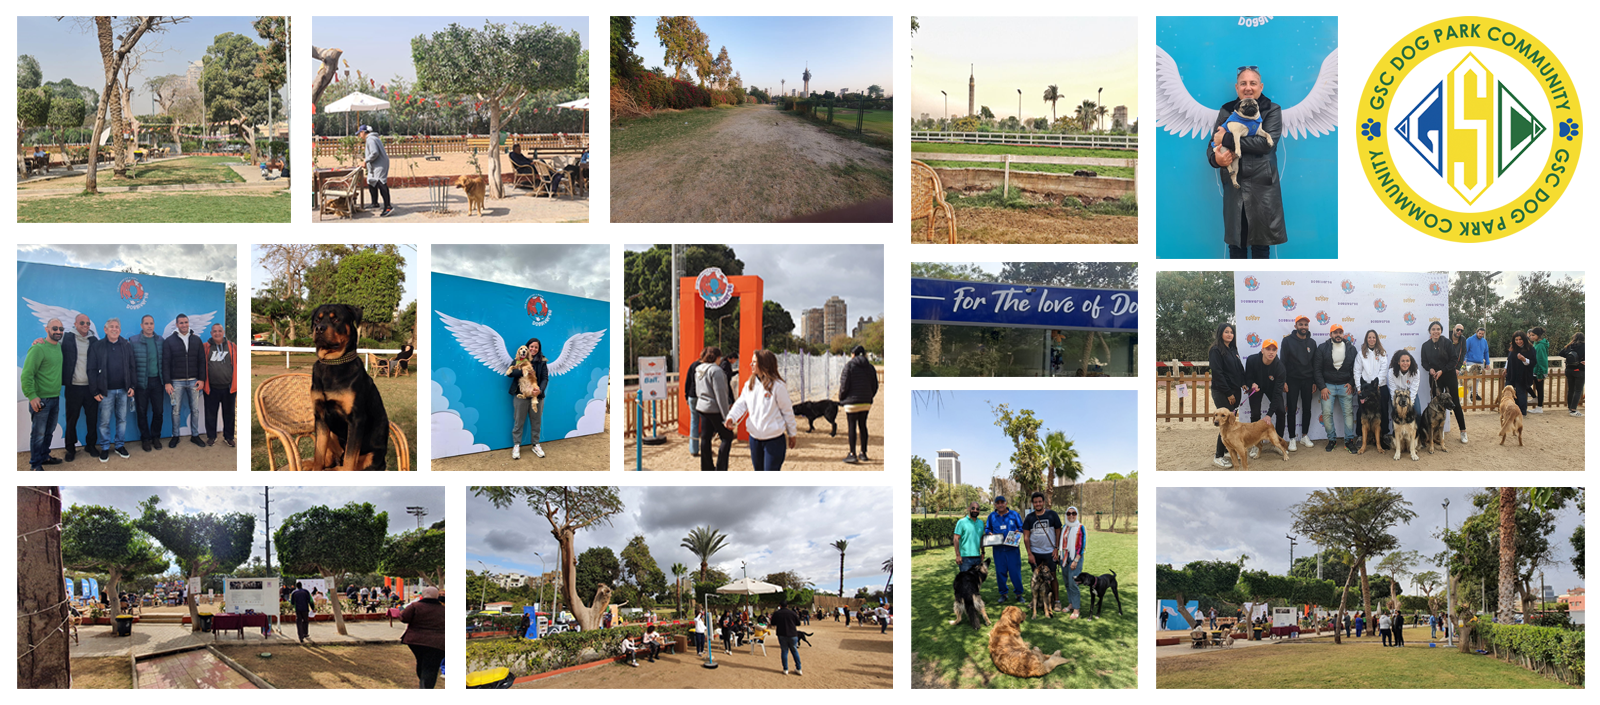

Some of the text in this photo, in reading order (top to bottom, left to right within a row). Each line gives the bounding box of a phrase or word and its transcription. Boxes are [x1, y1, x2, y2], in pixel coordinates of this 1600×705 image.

[1369, 23, 1571, 111] GSC DOG PARK COMMUNITY
[1368, 148, 1570, 237] GSC DOG PARK COMMUNITY
[953, 286, 987, 313] For
[991, 287, 1031, 314] The
[1037, 289, 1075, 314] love
[1081, 294, 1105, 320] of
